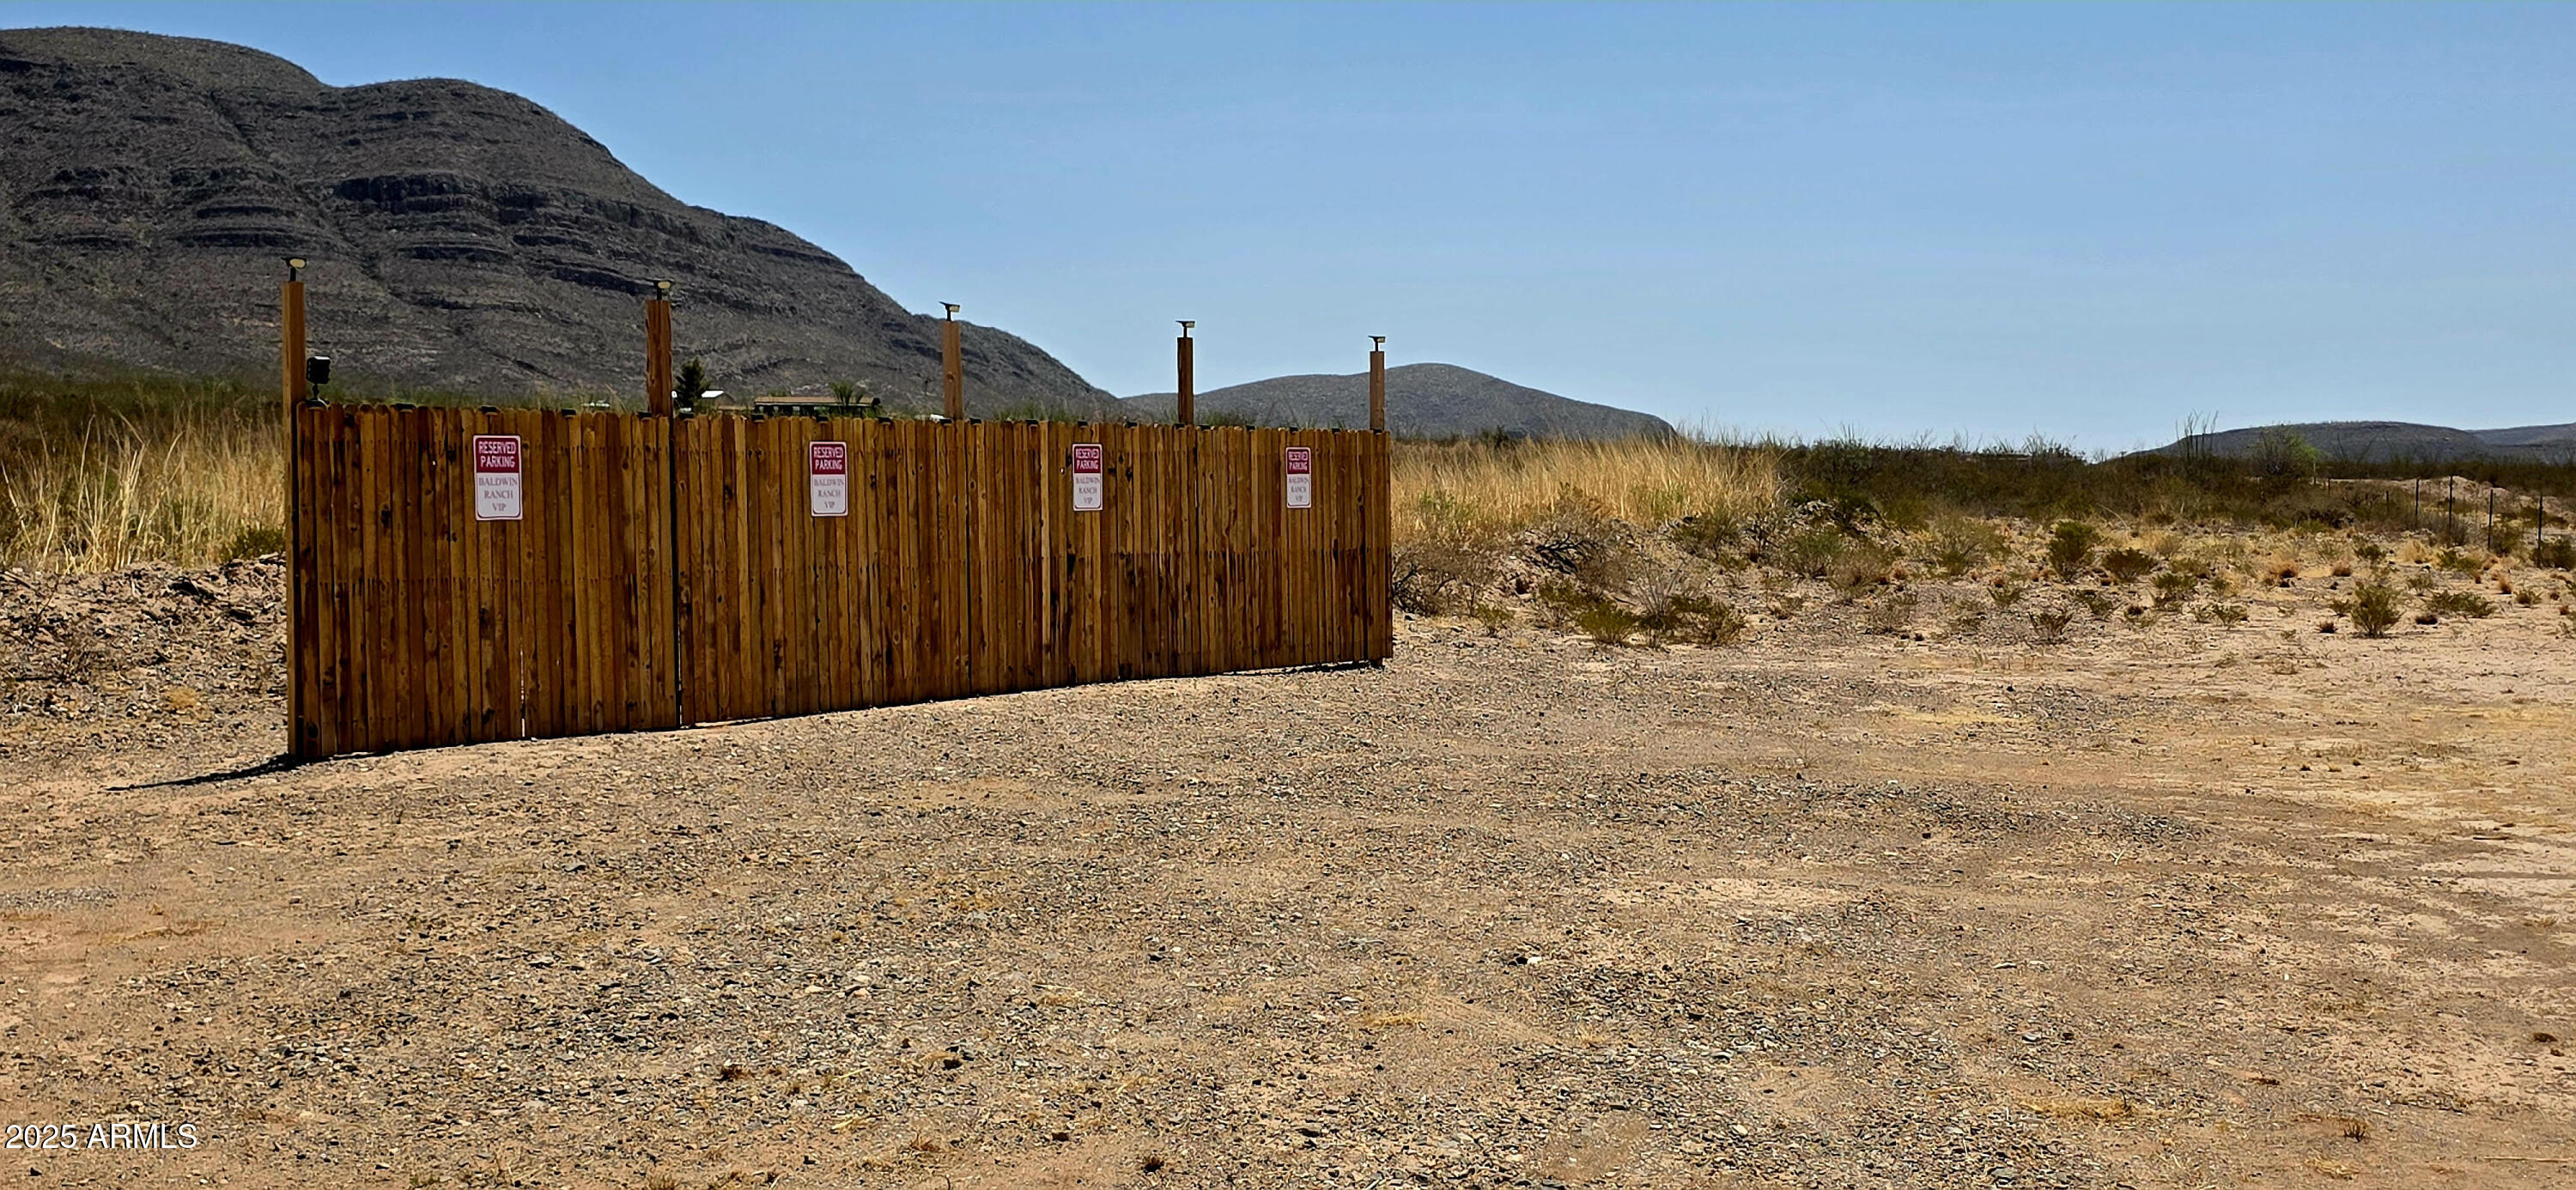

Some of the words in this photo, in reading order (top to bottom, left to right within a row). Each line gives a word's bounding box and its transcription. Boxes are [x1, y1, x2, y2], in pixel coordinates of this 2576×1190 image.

[478, 441, 517, 454] RESERVED
[813, 446, 844, 458] RESERVED
[480, 455, 515, 468] PARKING
[815, 459, 842, 471] PARKING
[1076, 459, 1099, 470] PARKING
[478, 477, 517, 486] BALDWIN
[483, 490, 513, 499] RANCH
